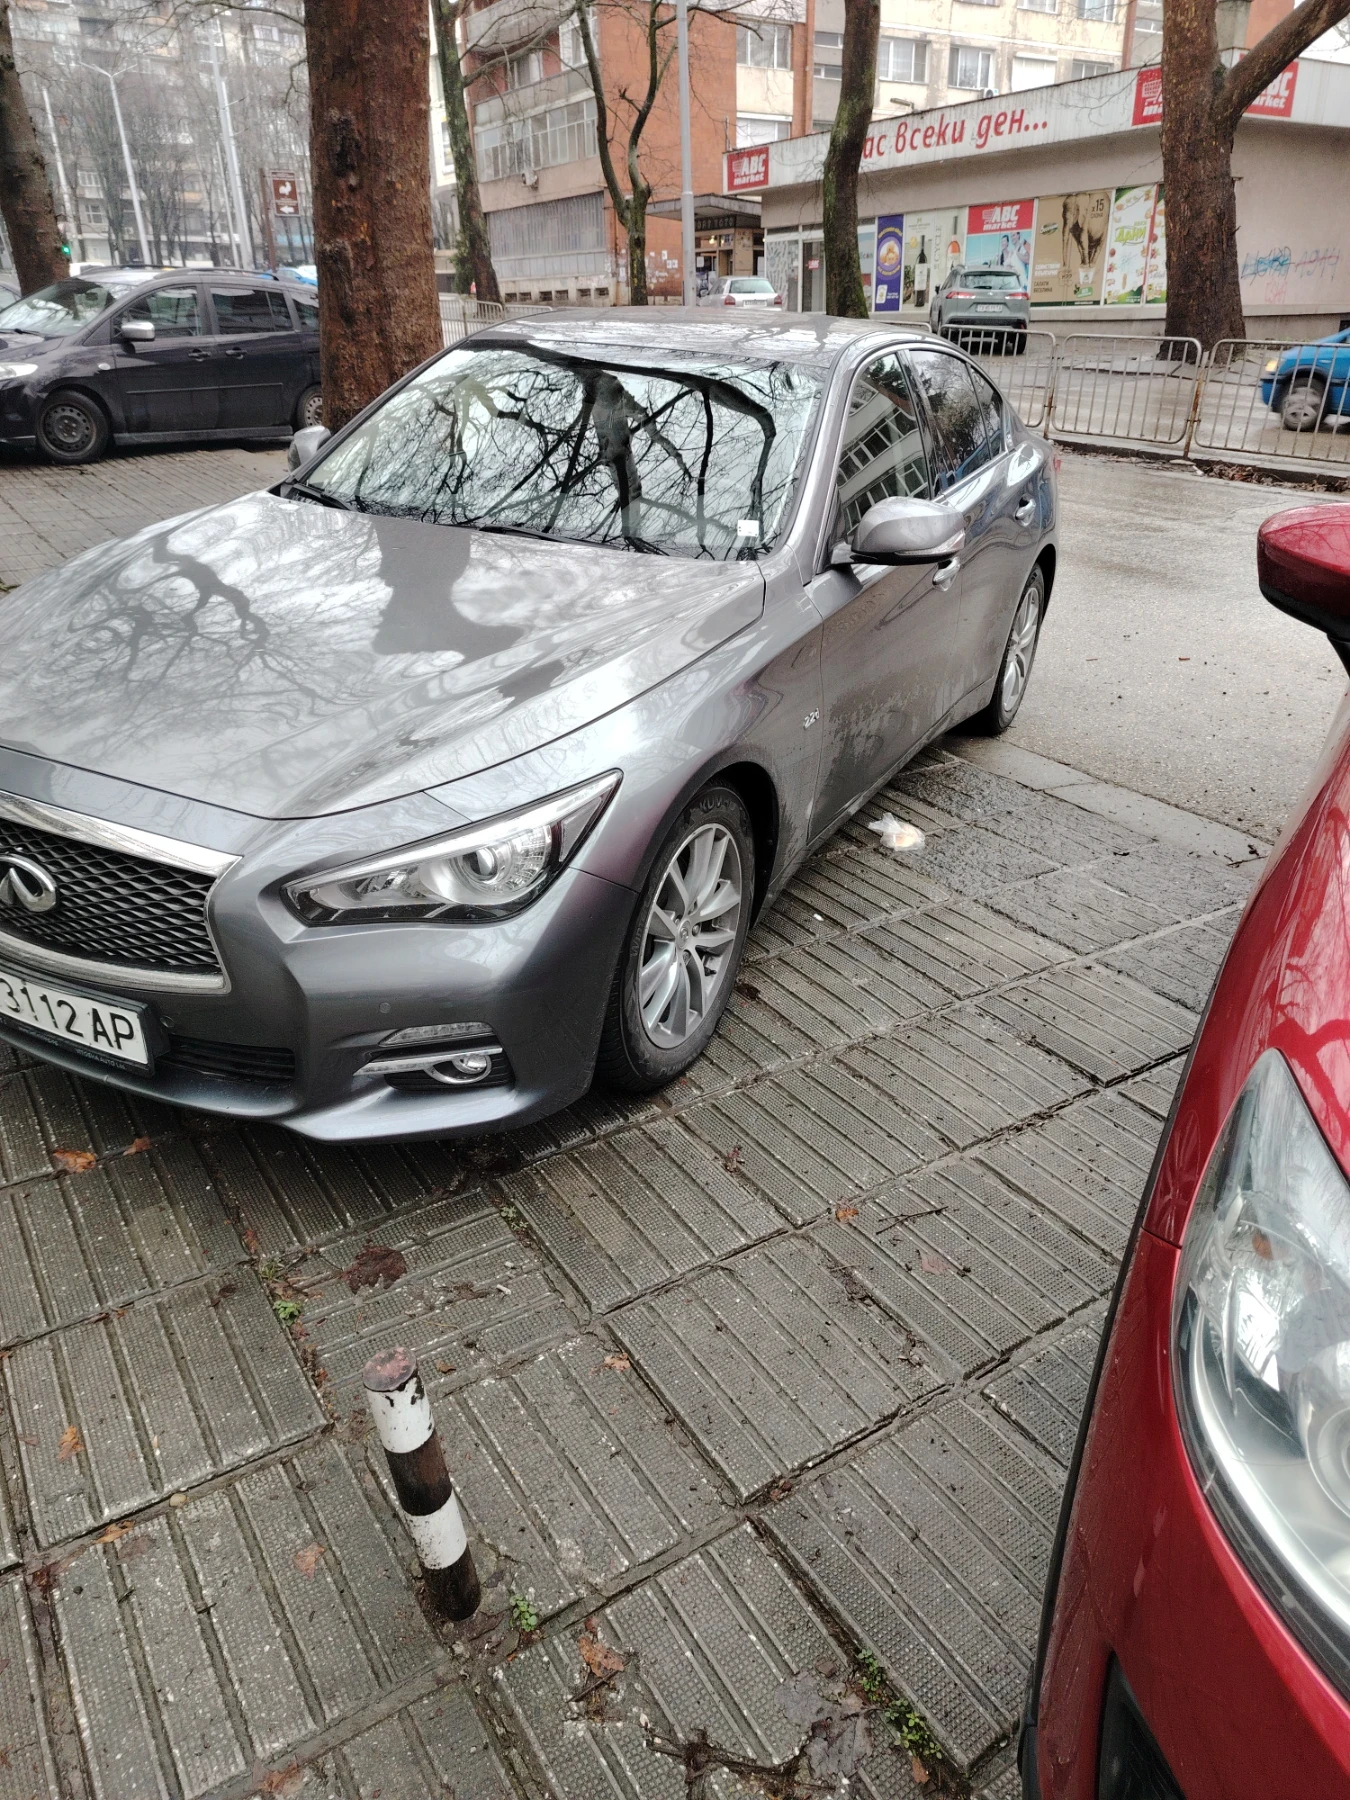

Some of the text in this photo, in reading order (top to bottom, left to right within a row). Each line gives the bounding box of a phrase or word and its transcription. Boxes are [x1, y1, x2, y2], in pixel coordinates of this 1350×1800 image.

[1261, 71, 1294, 97] BC
[862, 108, 1048, 160] ас всеки ден...
[741, 153, 767, 176] ABC
[733, 172, 765, 186] market
[991, 204, 1021, 223] ABC
[983, 220, 1017, 231] market
[91, 1007, 134, 1050] AP
